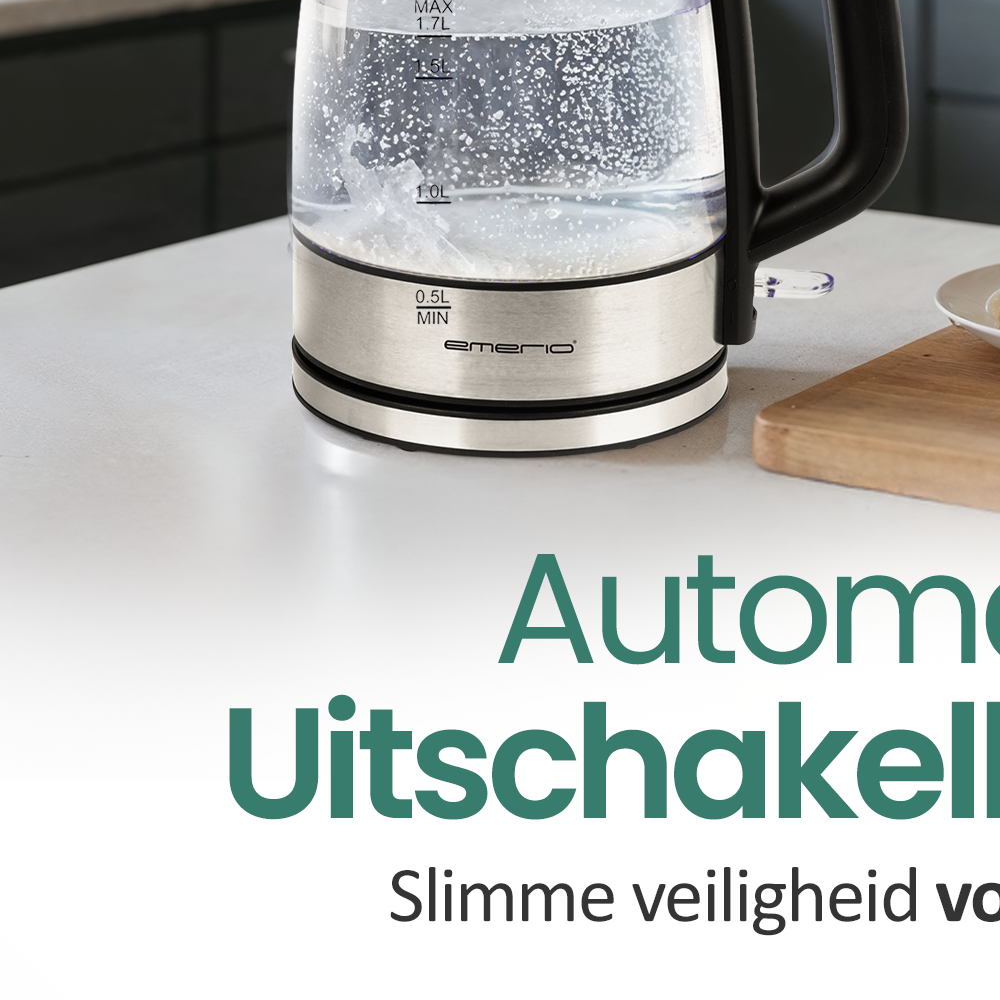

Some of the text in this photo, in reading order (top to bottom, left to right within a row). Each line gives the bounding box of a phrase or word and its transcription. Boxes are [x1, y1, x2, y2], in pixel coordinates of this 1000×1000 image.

[414, 0, 453, 13] MAX
[416, 16, 450, 30] 1.7L
[415, 58, 451, 73] 1.5L
[416, 185, 449, 198] 1.0L
[415, 290, 450, 304] 0.5L
[417, 311, 449, 325] MIN
[444, 339, 574, 354] emerio
